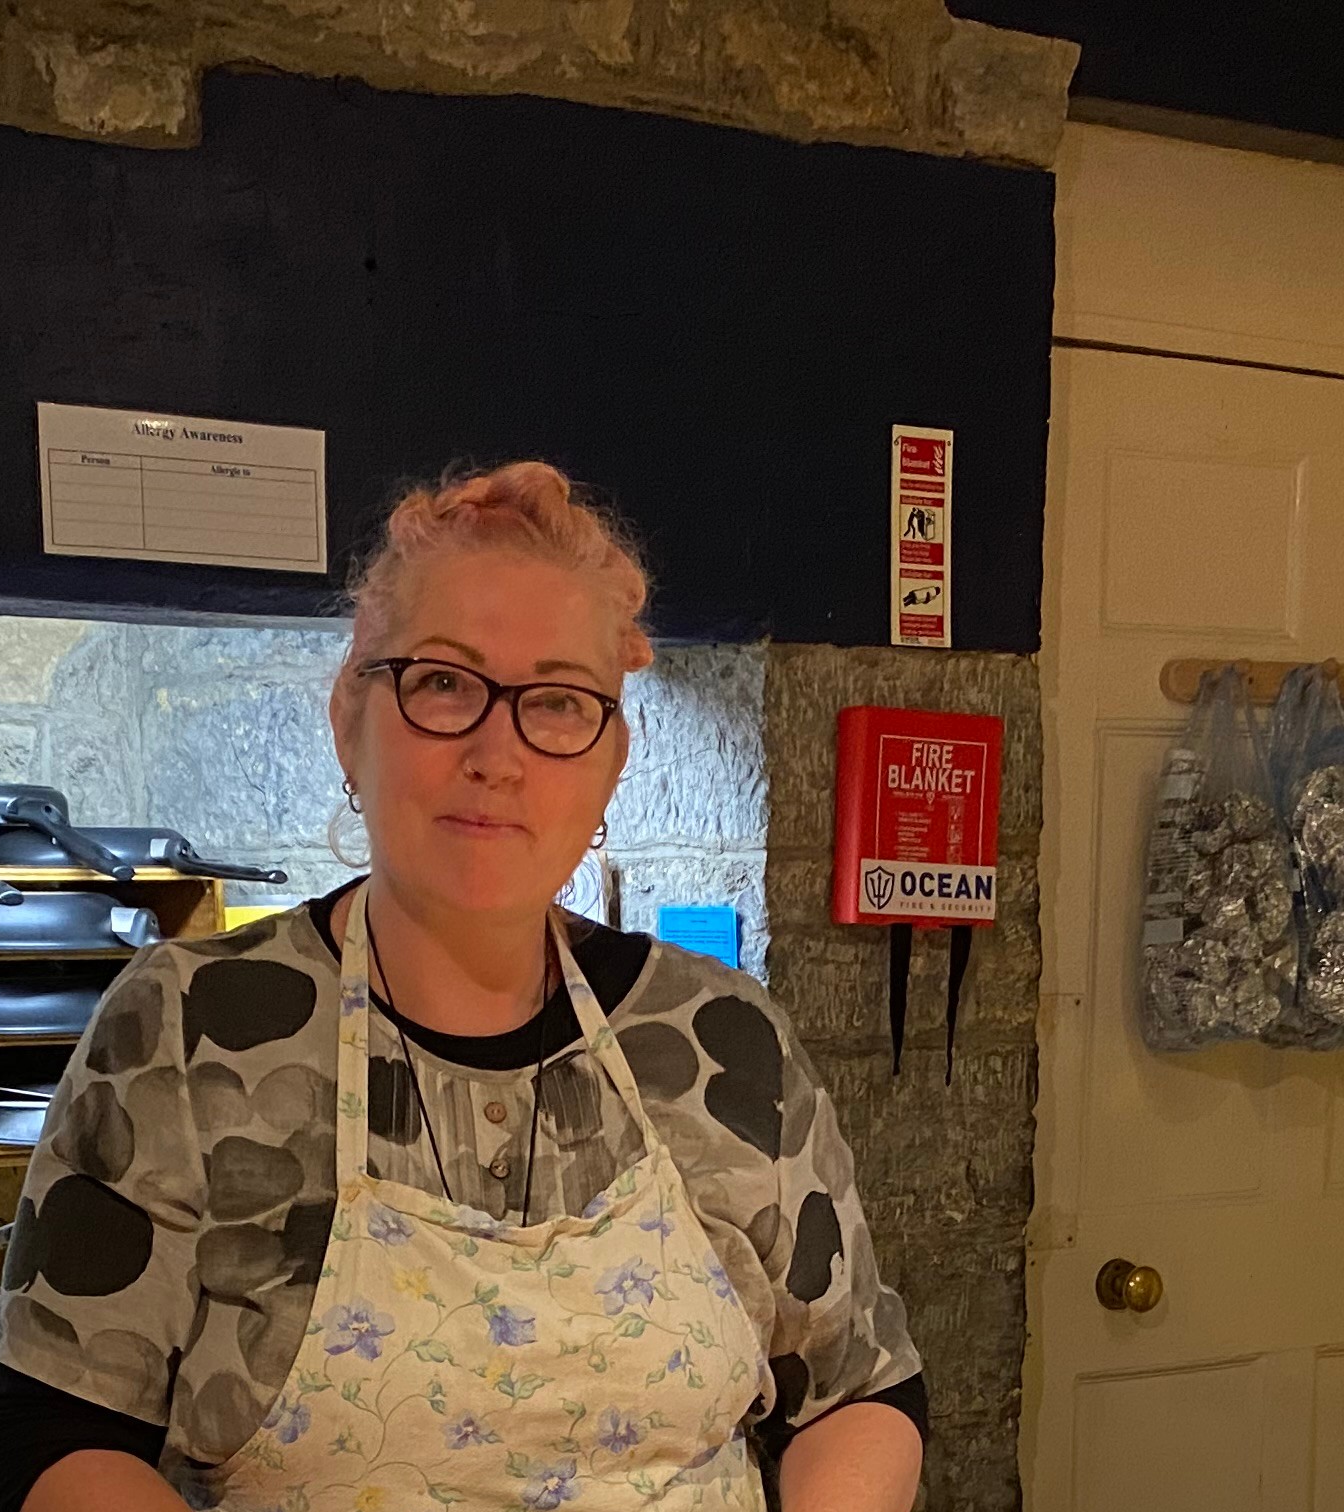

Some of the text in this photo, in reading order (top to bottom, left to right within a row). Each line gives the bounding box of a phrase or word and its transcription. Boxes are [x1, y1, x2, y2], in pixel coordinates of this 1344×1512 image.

[130, 420, 244, 445] Allergy Awareness
[80, 453, 112, 466] Person
[910, 743, 954, 769] FIRE
[887, 765, 976, 794] BLANKET
[900, 870, 994, 901] OCEAN
[899, 901, 924, 910] FIRE
[941, 903, 993, 914] SECURITY
